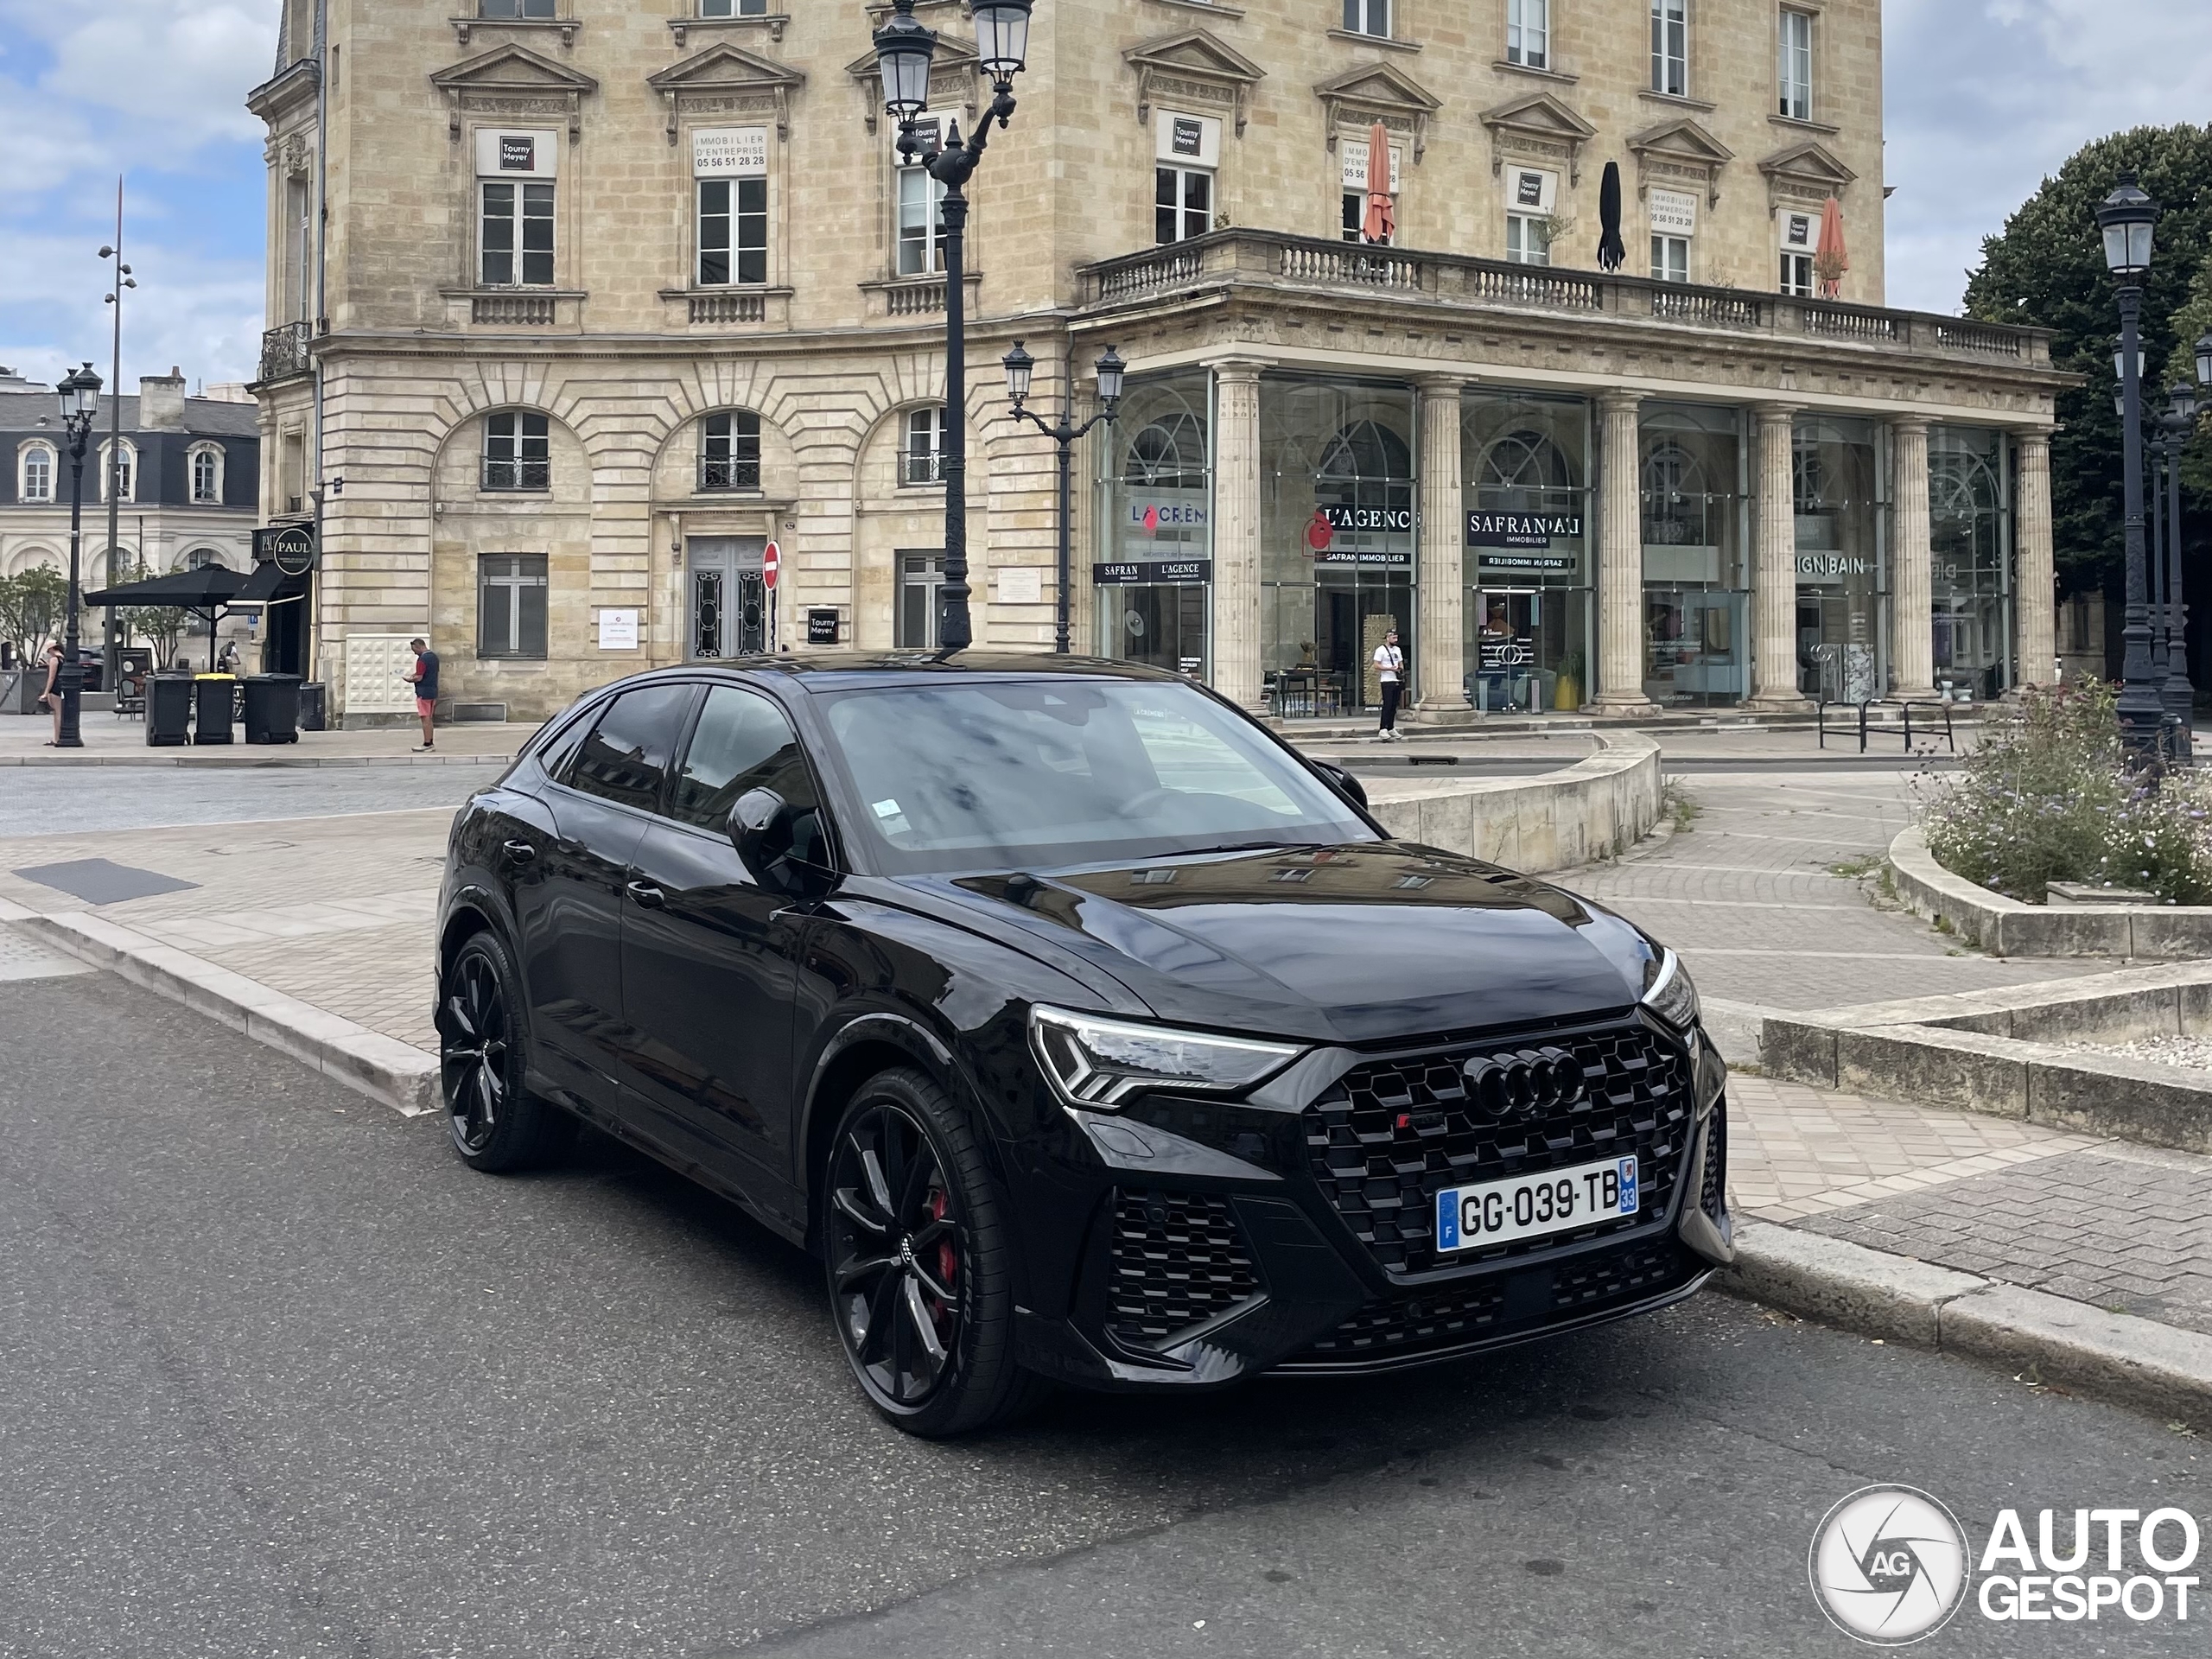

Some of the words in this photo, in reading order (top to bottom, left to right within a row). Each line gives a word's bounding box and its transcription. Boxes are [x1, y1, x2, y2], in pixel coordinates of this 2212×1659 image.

[1176, 126, 1198, 138] Tourny
[696, 136, 764, 145] IMMOBILIER
[503, 143, 531, 154] Tourny
[696, 146, 764, 156] D'ENTREPRISE
[503, 152, 528, 162] Meyer
[697, 158, 709, 167] 05
[711, 157, 722, 166] 56
[726, 157, 735, 166] 51
[740, 156, 750, 165] 28
[753, 156, 765, 165] 28
[1344, 168, 1354, 177] 05
[1356, 169, 1364, 179] 56
[1651, 194, 1694, 207] IMMOBILIER
[1651, 204, 1693, 216] COMMERCIAL
[1471, 515, 1546, 534] SAFRAN
[278, 542, 310, 553] PAUL
[1105, 565, 1138, 575] SAFRAN
[1161, 563, 1199, 574] L'AGENCE
[811, 618, 836, 627] Tourny
[1461, 1168, 1618, 1236] GG-039-TB
[1621, 1187, 1635, 1208] 33
[1445, 1225, 1452, 1239] F
